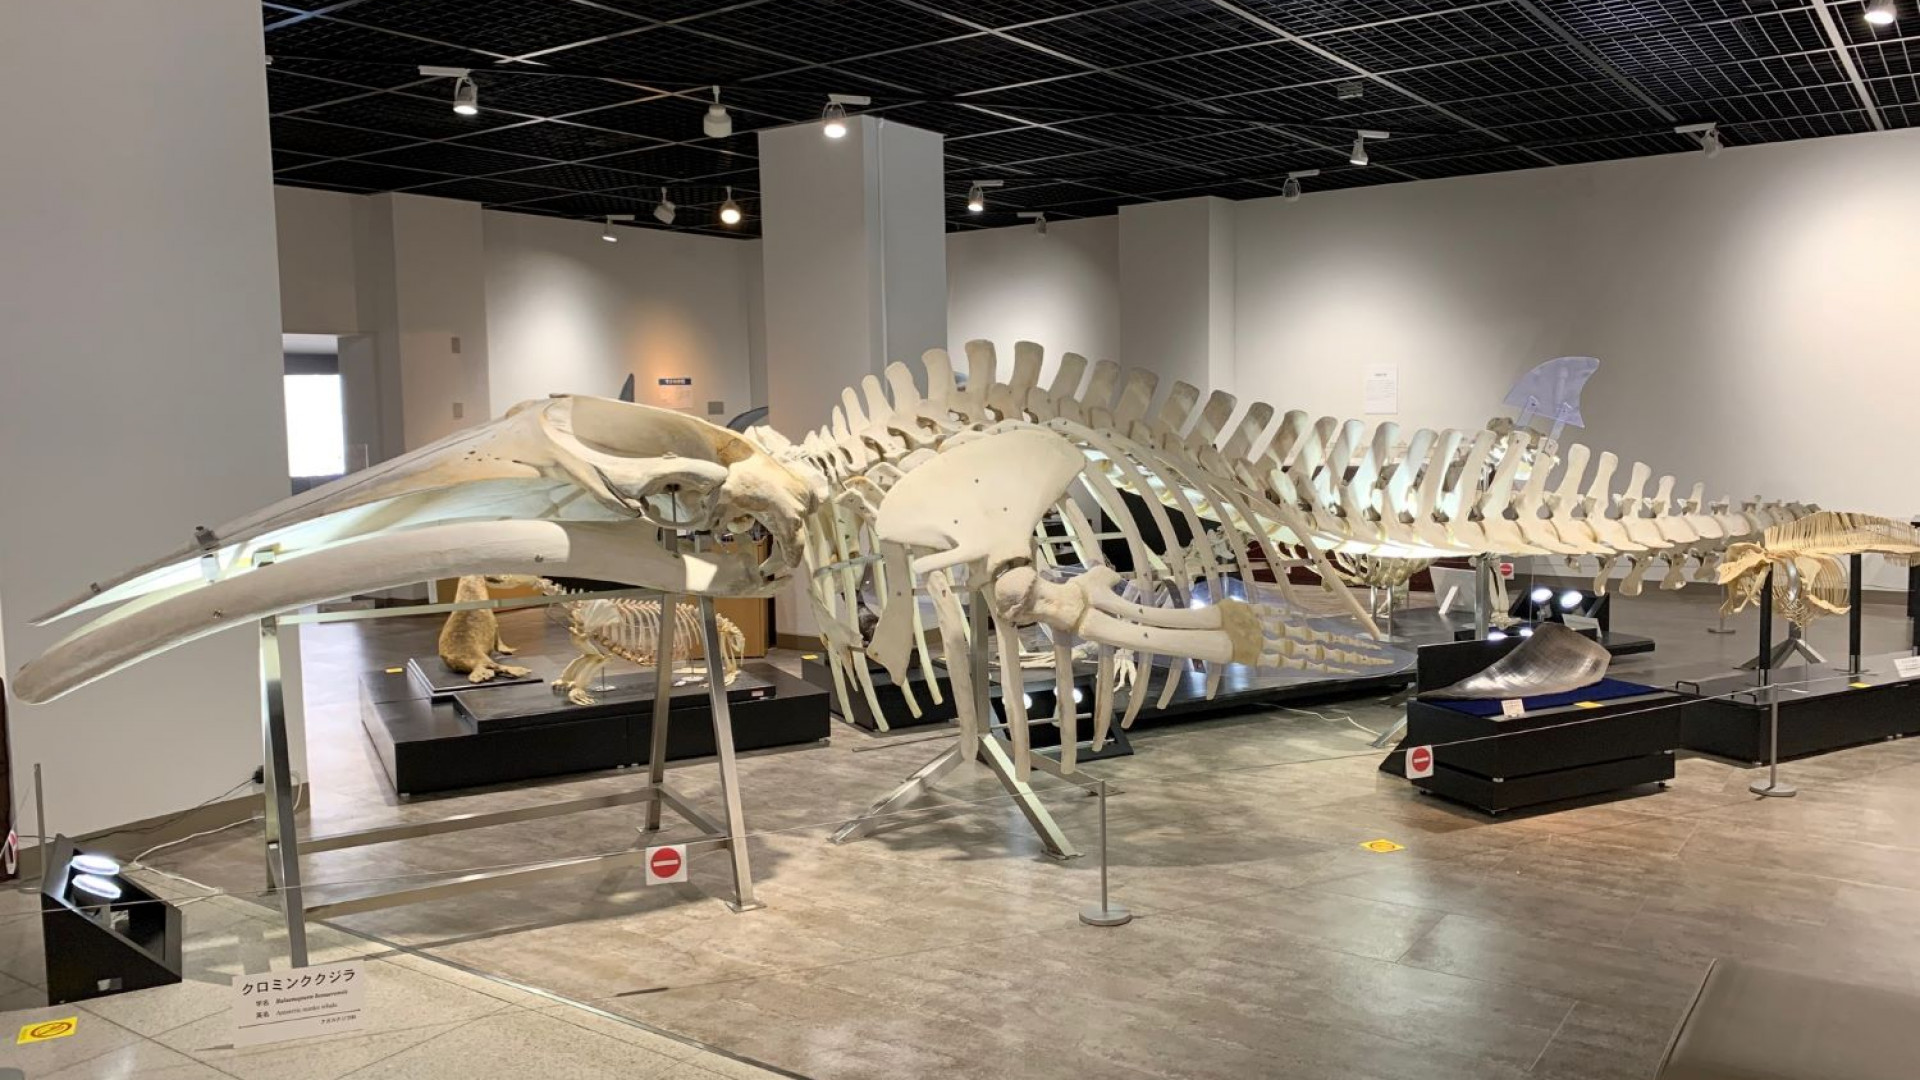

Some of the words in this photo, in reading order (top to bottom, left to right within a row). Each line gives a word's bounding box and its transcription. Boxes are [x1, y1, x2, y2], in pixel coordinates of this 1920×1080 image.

[242, 968, 356, 996] クロミンククジラ
